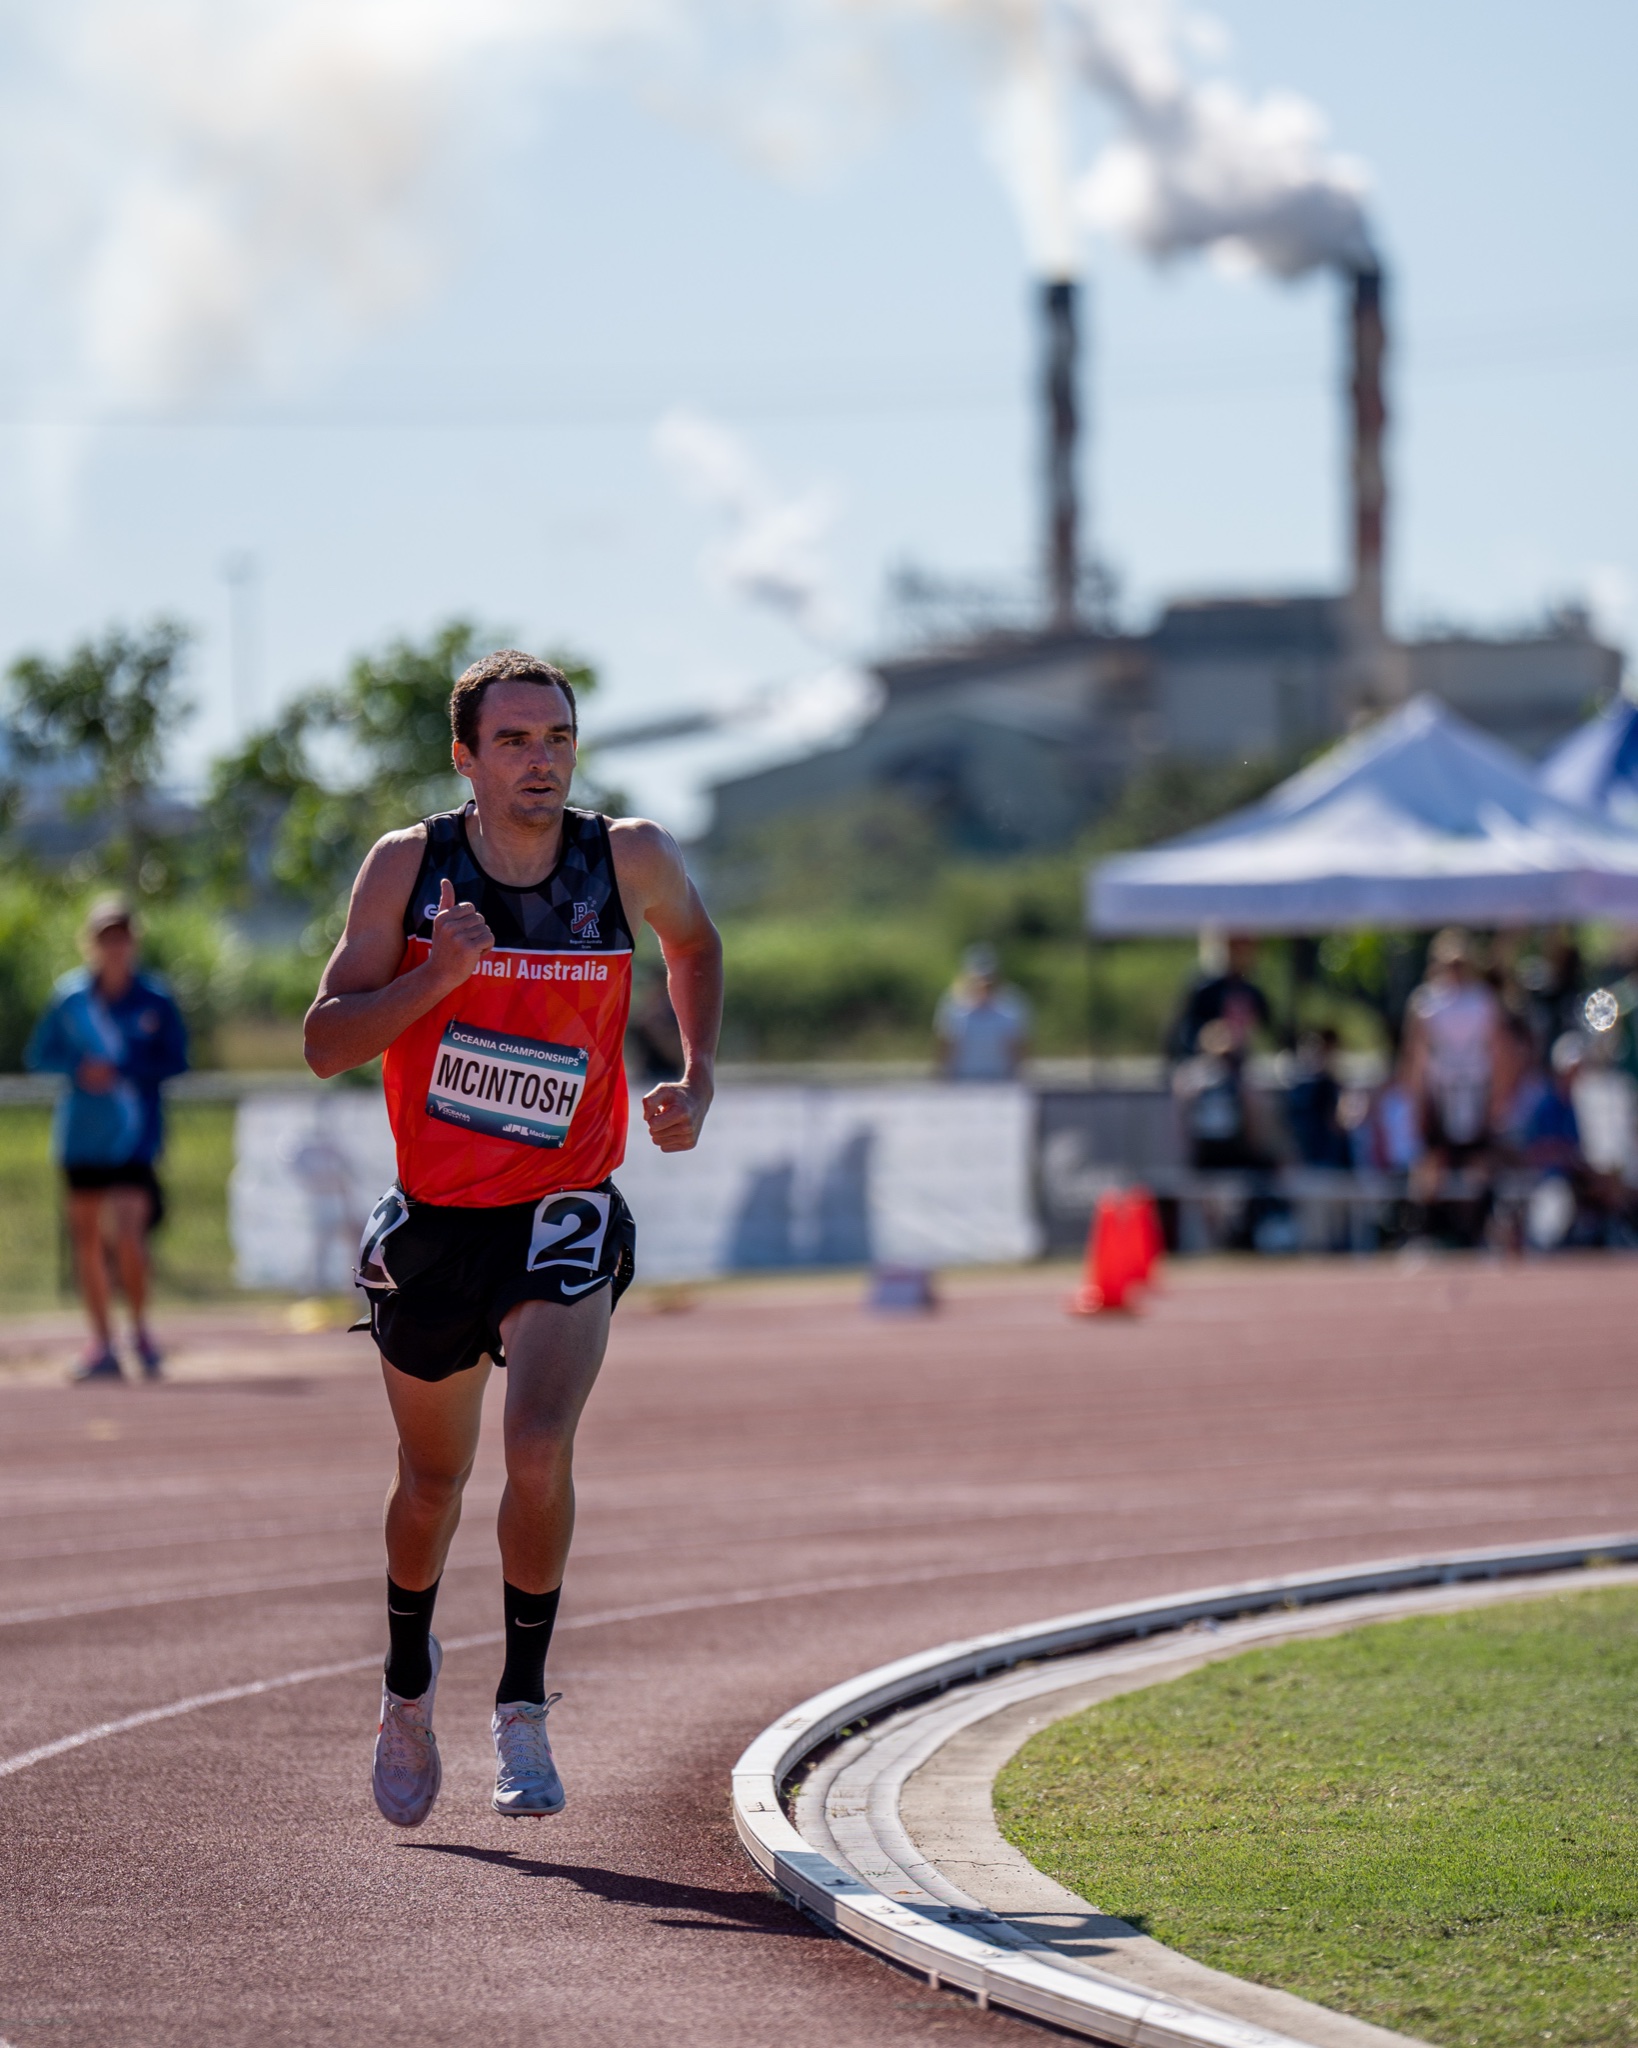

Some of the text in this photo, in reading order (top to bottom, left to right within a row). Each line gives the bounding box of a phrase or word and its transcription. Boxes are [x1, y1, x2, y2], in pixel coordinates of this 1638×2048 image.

[516, 959, 609, 981] Australia
[452, 1031, 580, 1067] OCEANIA CHAMPIONSHIPS
[436, 1053, 578, 1117] MCINTOSH
[442, 1107, 471, 1119] OCEANIA
[529, 1129, 552, 1140] Mackay
[360, 1194, 403, 1284] 2
[532, 1196, 602, 1266] 2
